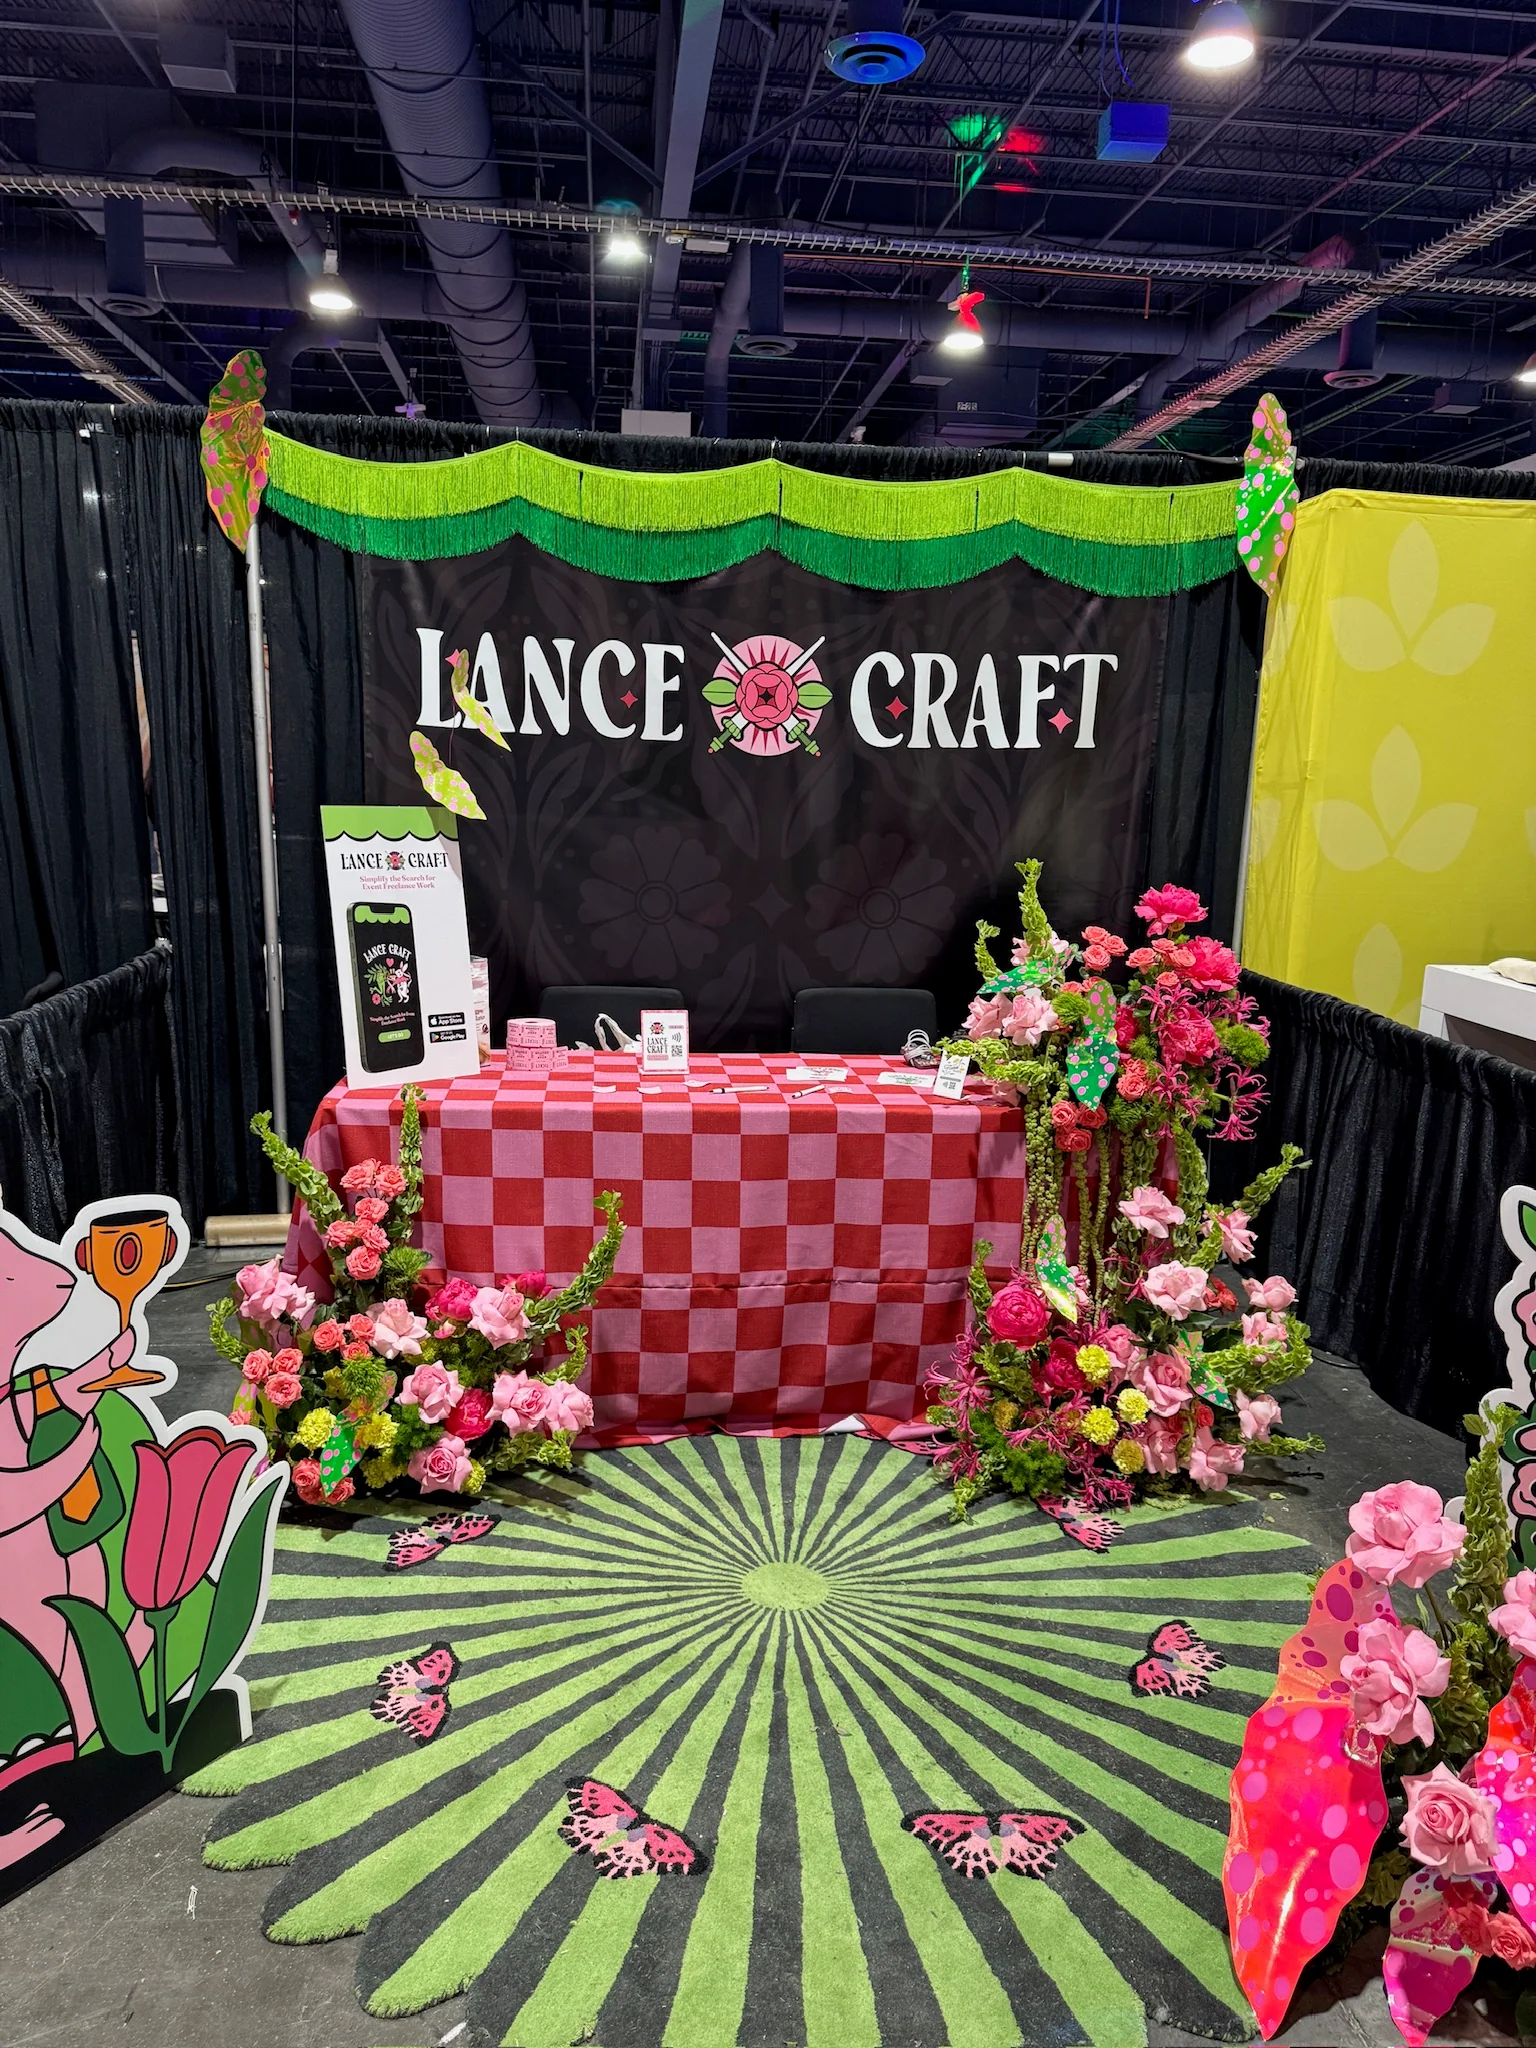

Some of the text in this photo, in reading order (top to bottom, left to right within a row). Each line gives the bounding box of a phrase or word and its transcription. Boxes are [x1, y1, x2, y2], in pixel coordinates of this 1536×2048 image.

[415, 627, 1119, 749] LANCE CRAFT
[340, 852, 449, 870] LANCE CRAFT
[359, 874, 436, 884] Simplify the Search for
[383, 882, 416, 890] Freelance
[416, 881, 436, 889] Work
[363, 943, 412, 964] LANCE CRAFT
[647, 1037, 668, 1046] LANCE
[646, 1045, 668, 1054] CRAFT
